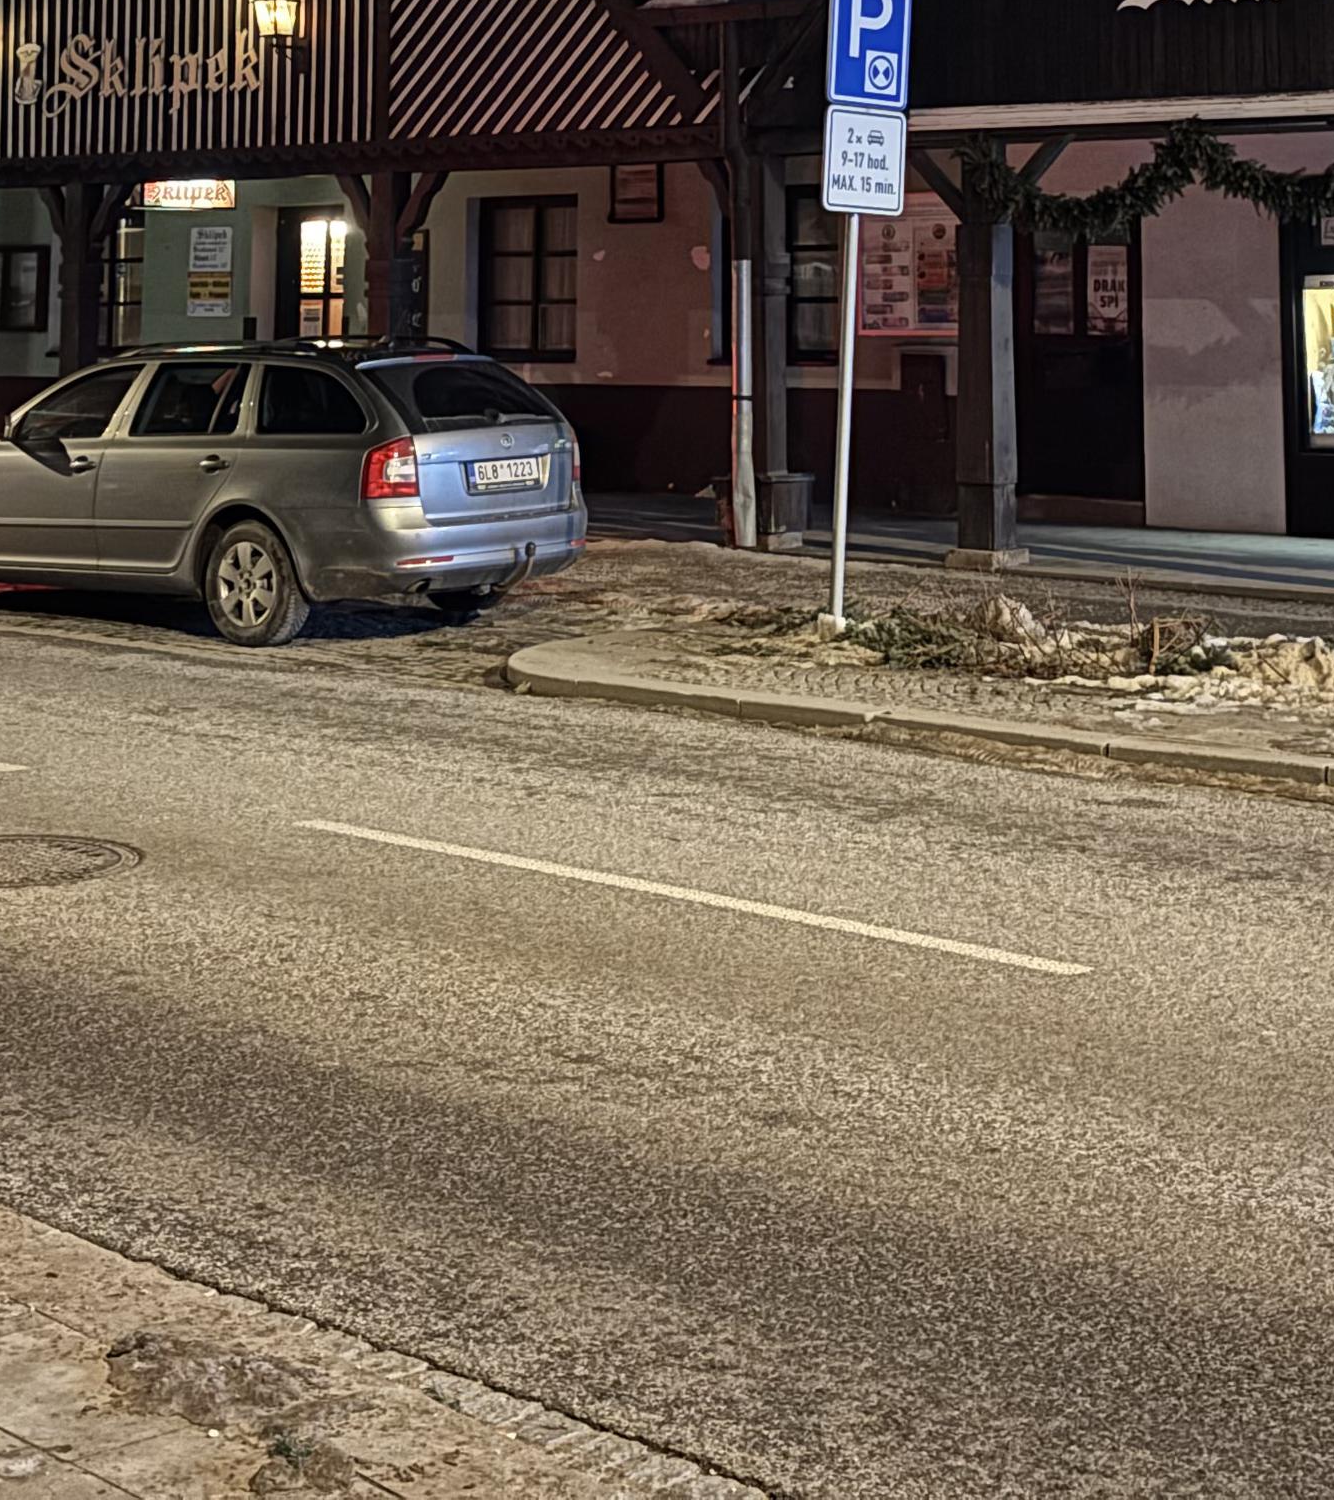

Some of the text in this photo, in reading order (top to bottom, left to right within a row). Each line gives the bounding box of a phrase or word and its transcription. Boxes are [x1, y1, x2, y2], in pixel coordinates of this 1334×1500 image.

[841, 150, 889, 171] 9-17 hod.
[831, 173, 897, 196] MAX. 15 min.
[478, 461, 533, 481] 6L8 1223
